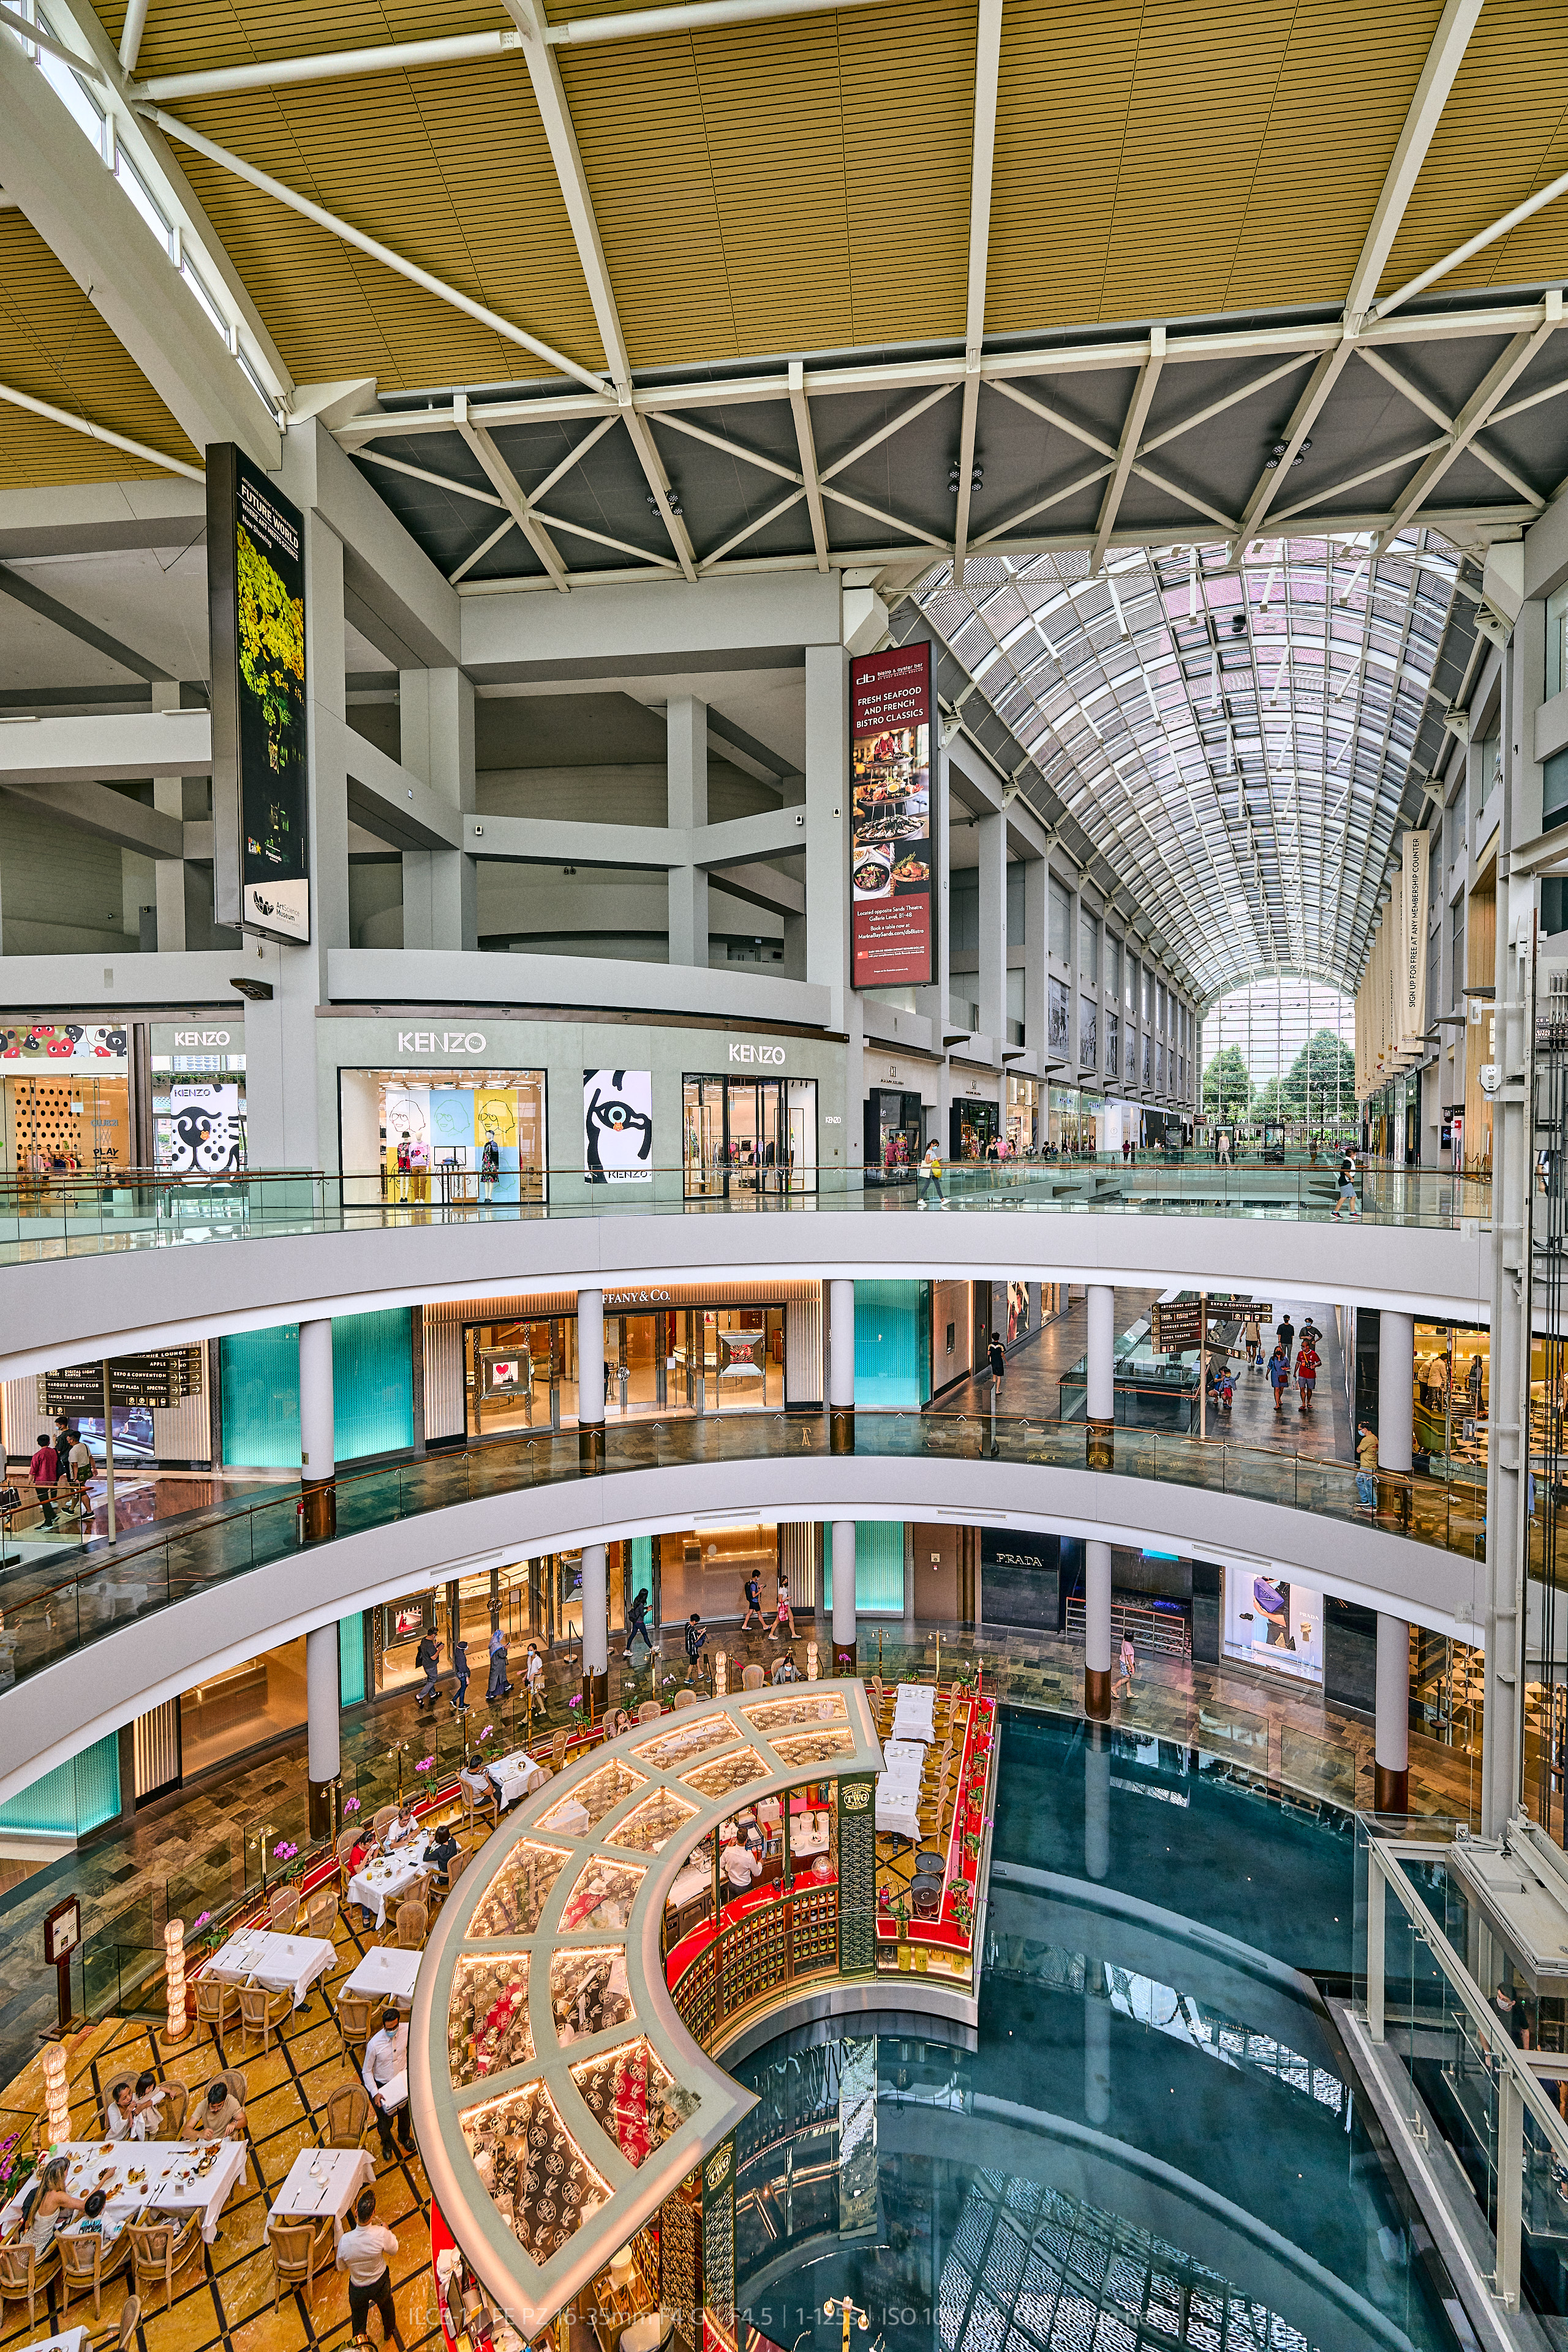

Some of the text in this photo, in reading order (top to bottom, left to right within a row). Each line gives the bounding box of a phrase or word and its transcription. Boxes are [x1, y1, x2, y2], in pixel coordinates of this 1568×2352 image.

[241, 484, 298, 549] FUTURE WORLD
[242, 502, 298, 561] WHERE ART MEETS SCIENCE
[243, 514, 272, 548] Now Showing
[856, 674, 875, 685] db
[858, 687, 922, 706] FRESH SEAFOOD
[864, 699, 915, 715] AND FRENCH
[856, 709, 924, 728] BISTRO CLASSICS
[276, 902, 300, 917] ArtScience
[277, 909, 295, 921] Museum
[858, 929, 924, 939] MarinaBaySands.com/dbBistro
[1411, 937, 1417, 946] AT
[1410, 980, 1416, 989] UP
[175, 1030, 230, 1046] KENZO
[398, 1031, 486, 1054] KENZO
[729, 1043, 786, 1066] KENZO
[174, 1088, 211, 1098] KENZO
[93, 1148, 119, 1156] PLAY
[603, 1302, 638, 1330] FFANY
[641, 1298, 649, 1324] &
[995, 1553, 1042, 1567] PRADA
[1299, 1611, 1319, 1621] PRADA
[846, 1793, 867, 1803] TWG
